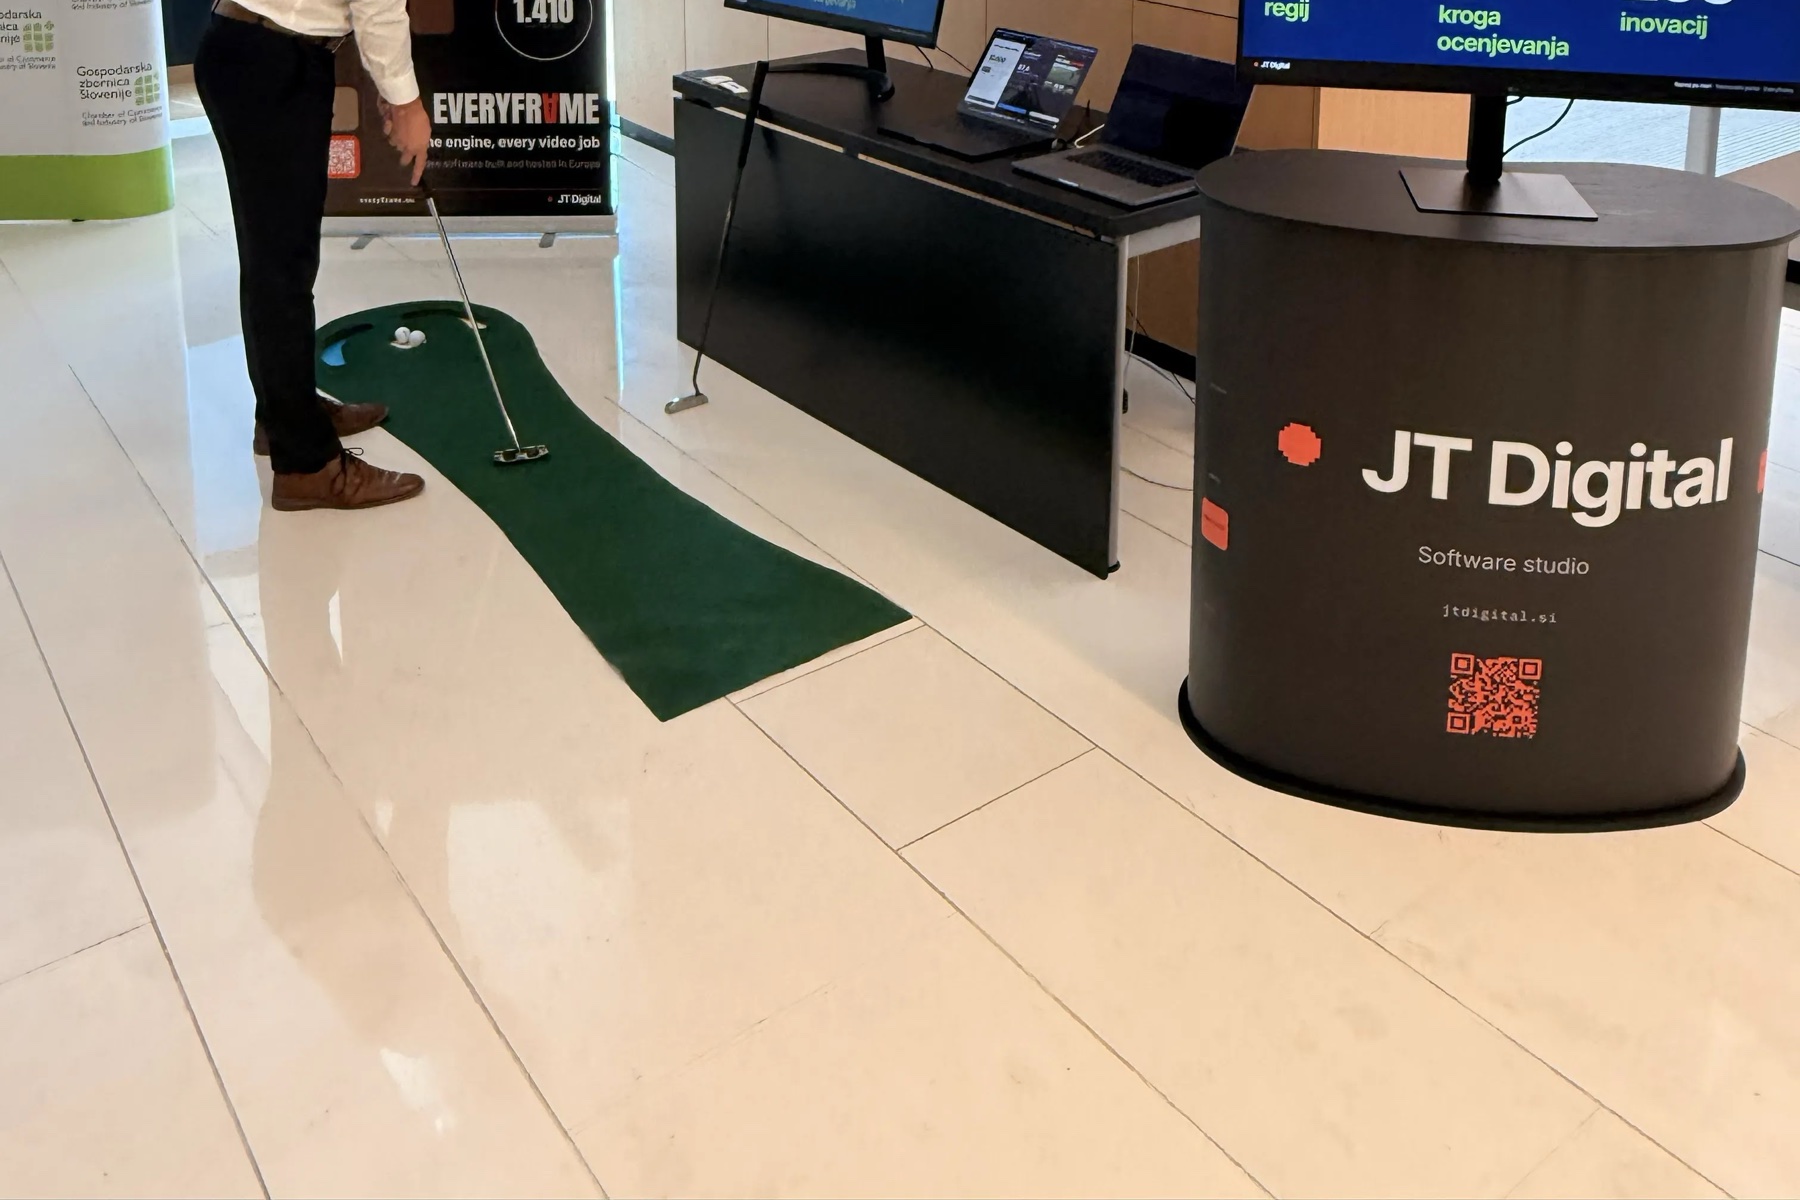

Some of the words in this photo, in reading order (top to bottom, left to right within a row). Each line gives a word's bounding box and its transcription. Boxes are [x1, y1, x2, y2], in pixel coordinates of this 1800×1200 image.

[1438, 5, 1501, 30] kroga
[1620, 11, 1708, 40] inovacij
[1437, 33, 1570, 61] ocenjevanja
[76, 62, 152, 79] Gospodarska
[79, 78, 130, 88] zbornica
[80, 88, 132, 102] Slovenije
[433, 92, 600, 125] EVERYFRAME
[429, 137, 442, 148] ne
[446, 135, 495, 150] engine,
[498, 138, 537, 151] every
[538, 135, 576, 148] video
[576, 135, 600, 151] job
[557, 194, 570, 204] JT
[571, 194, 602, 205] Digital
[1362, 430, 1473, 500] JT
[1488, 437, 1734, 527] Digital
[1418, 545, 1516, 572] Software
[1522, 557, 1590, 575] studio
[1442, 604, 1557, 623] jtdigital.si
